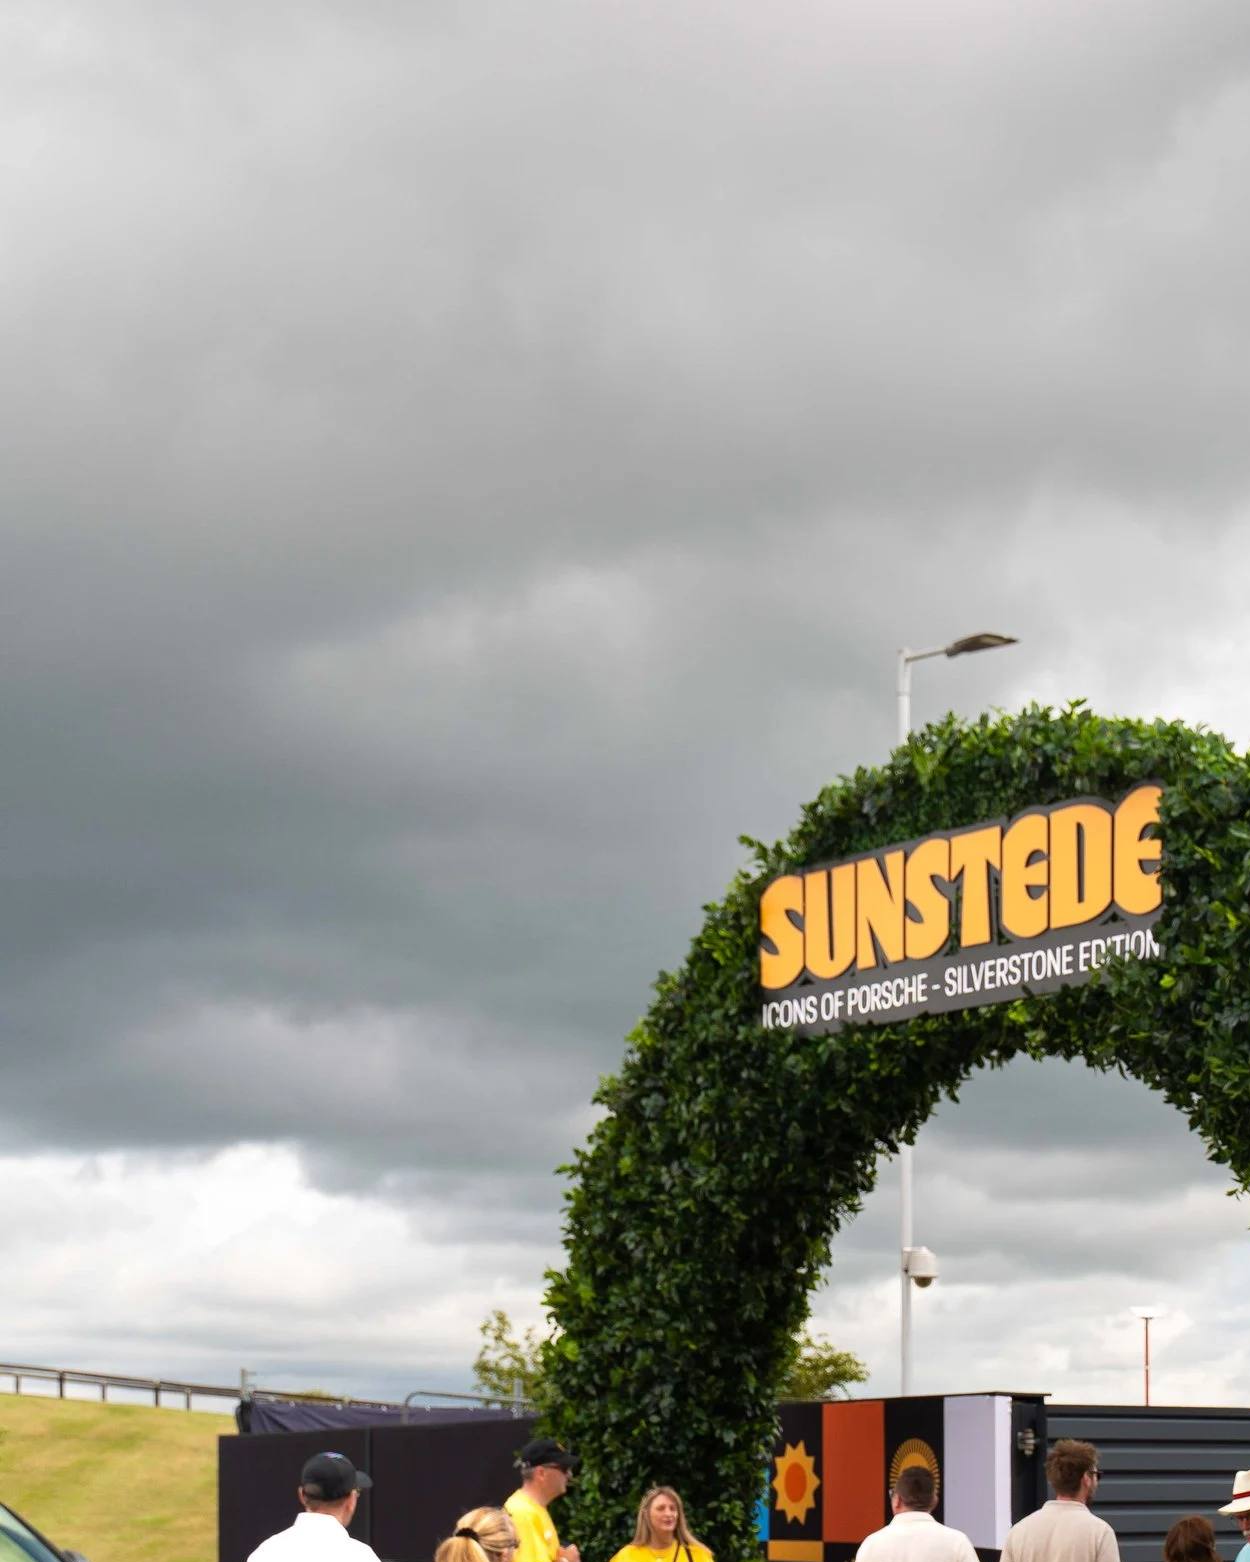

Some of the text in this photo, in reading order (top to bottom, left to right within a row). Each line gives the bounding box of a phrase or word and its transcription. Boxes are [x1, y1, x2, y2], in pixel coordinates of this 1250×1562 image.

[760, 785, 1163, 990] SUNSTEDE
[762, 995, 818, 1030] ICONS
[820, 990, 845, 1021] OF
[847, 972, 928, 1016] PORSCHE
[944, 944, 1074, 997] SILVERSTONE
